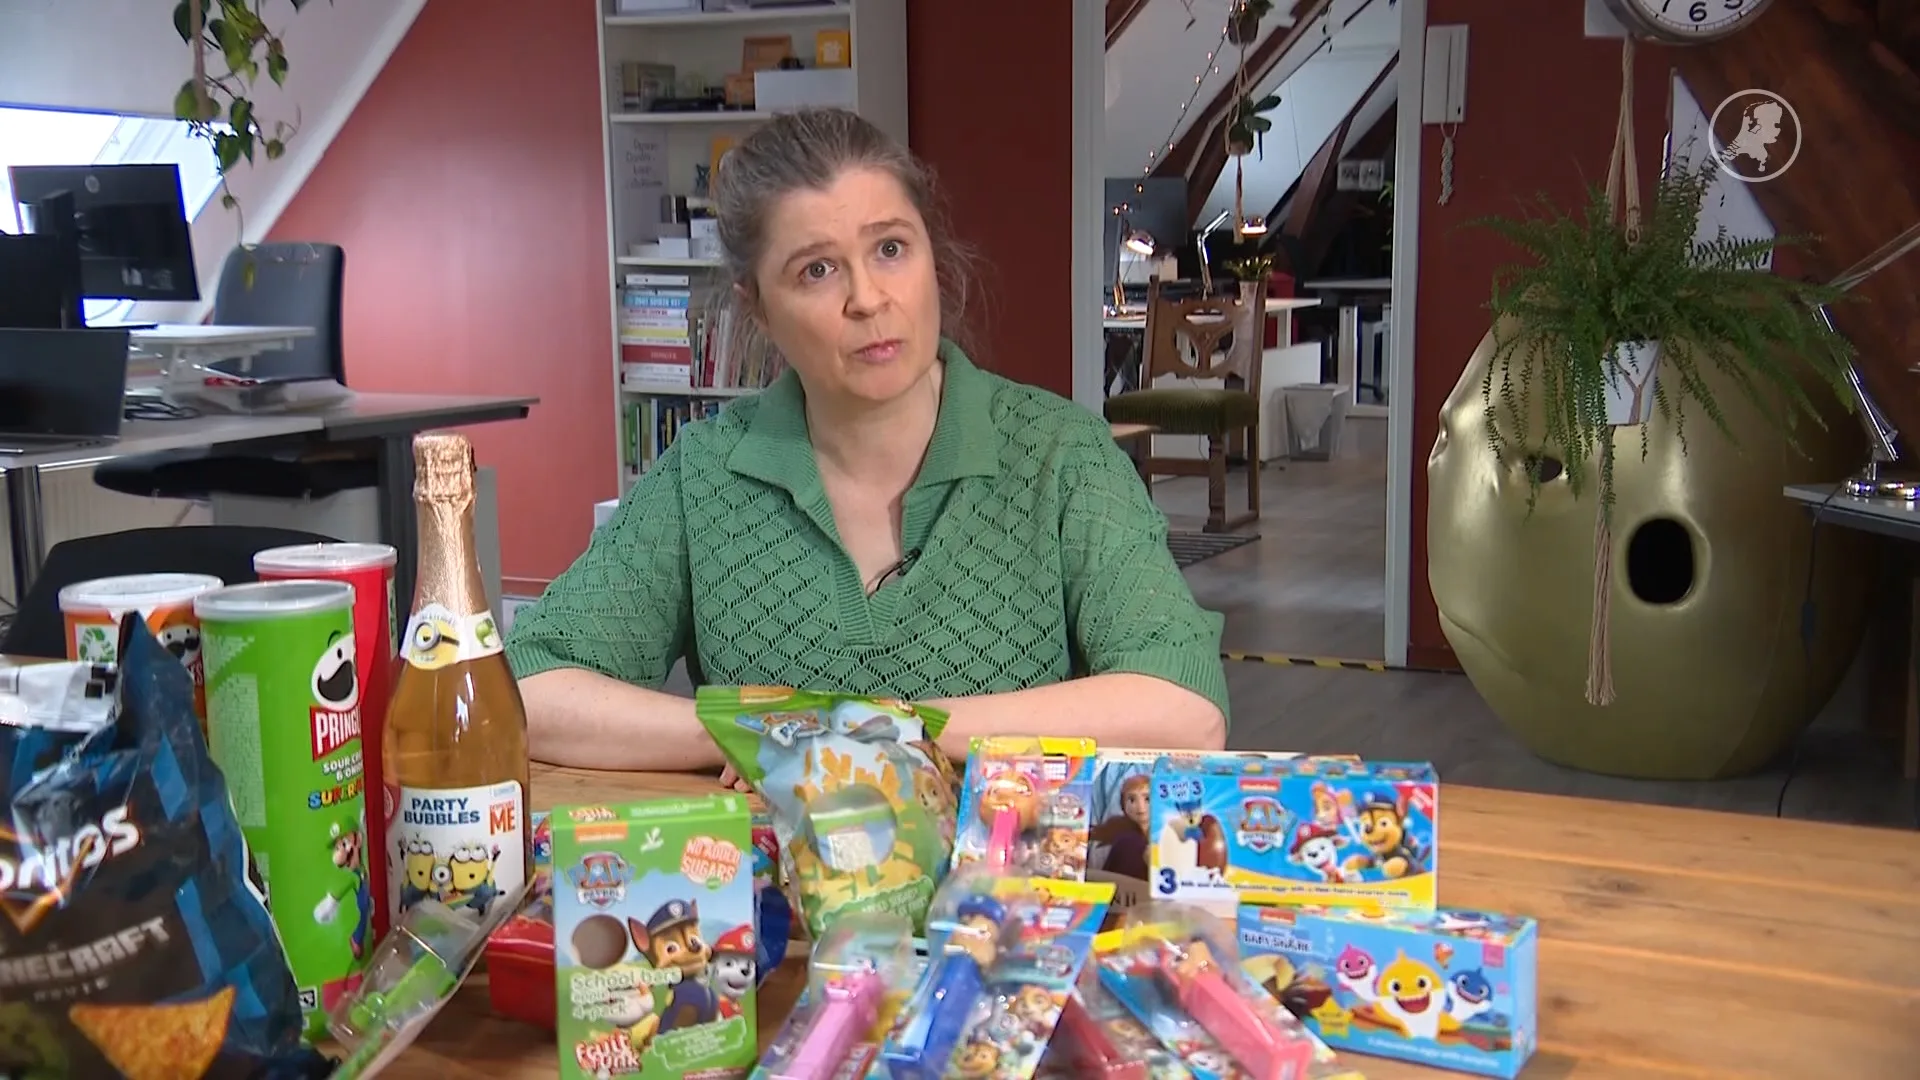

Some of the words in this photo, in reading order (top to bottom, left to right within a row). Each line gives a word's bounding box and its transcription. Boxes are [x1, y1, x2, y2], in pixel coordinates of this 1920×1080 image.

[1689, 2, 1707, 22] 6
[411, 797, 468, 811] PARTY
[404, 810, 480, 825] BUBBLES
[490, 804, 515, 835] ME
[688, 839, 704, 857] NO
[680, 855, 737, 883] SUGARS
[1159, 868, 1177, 894] 3
